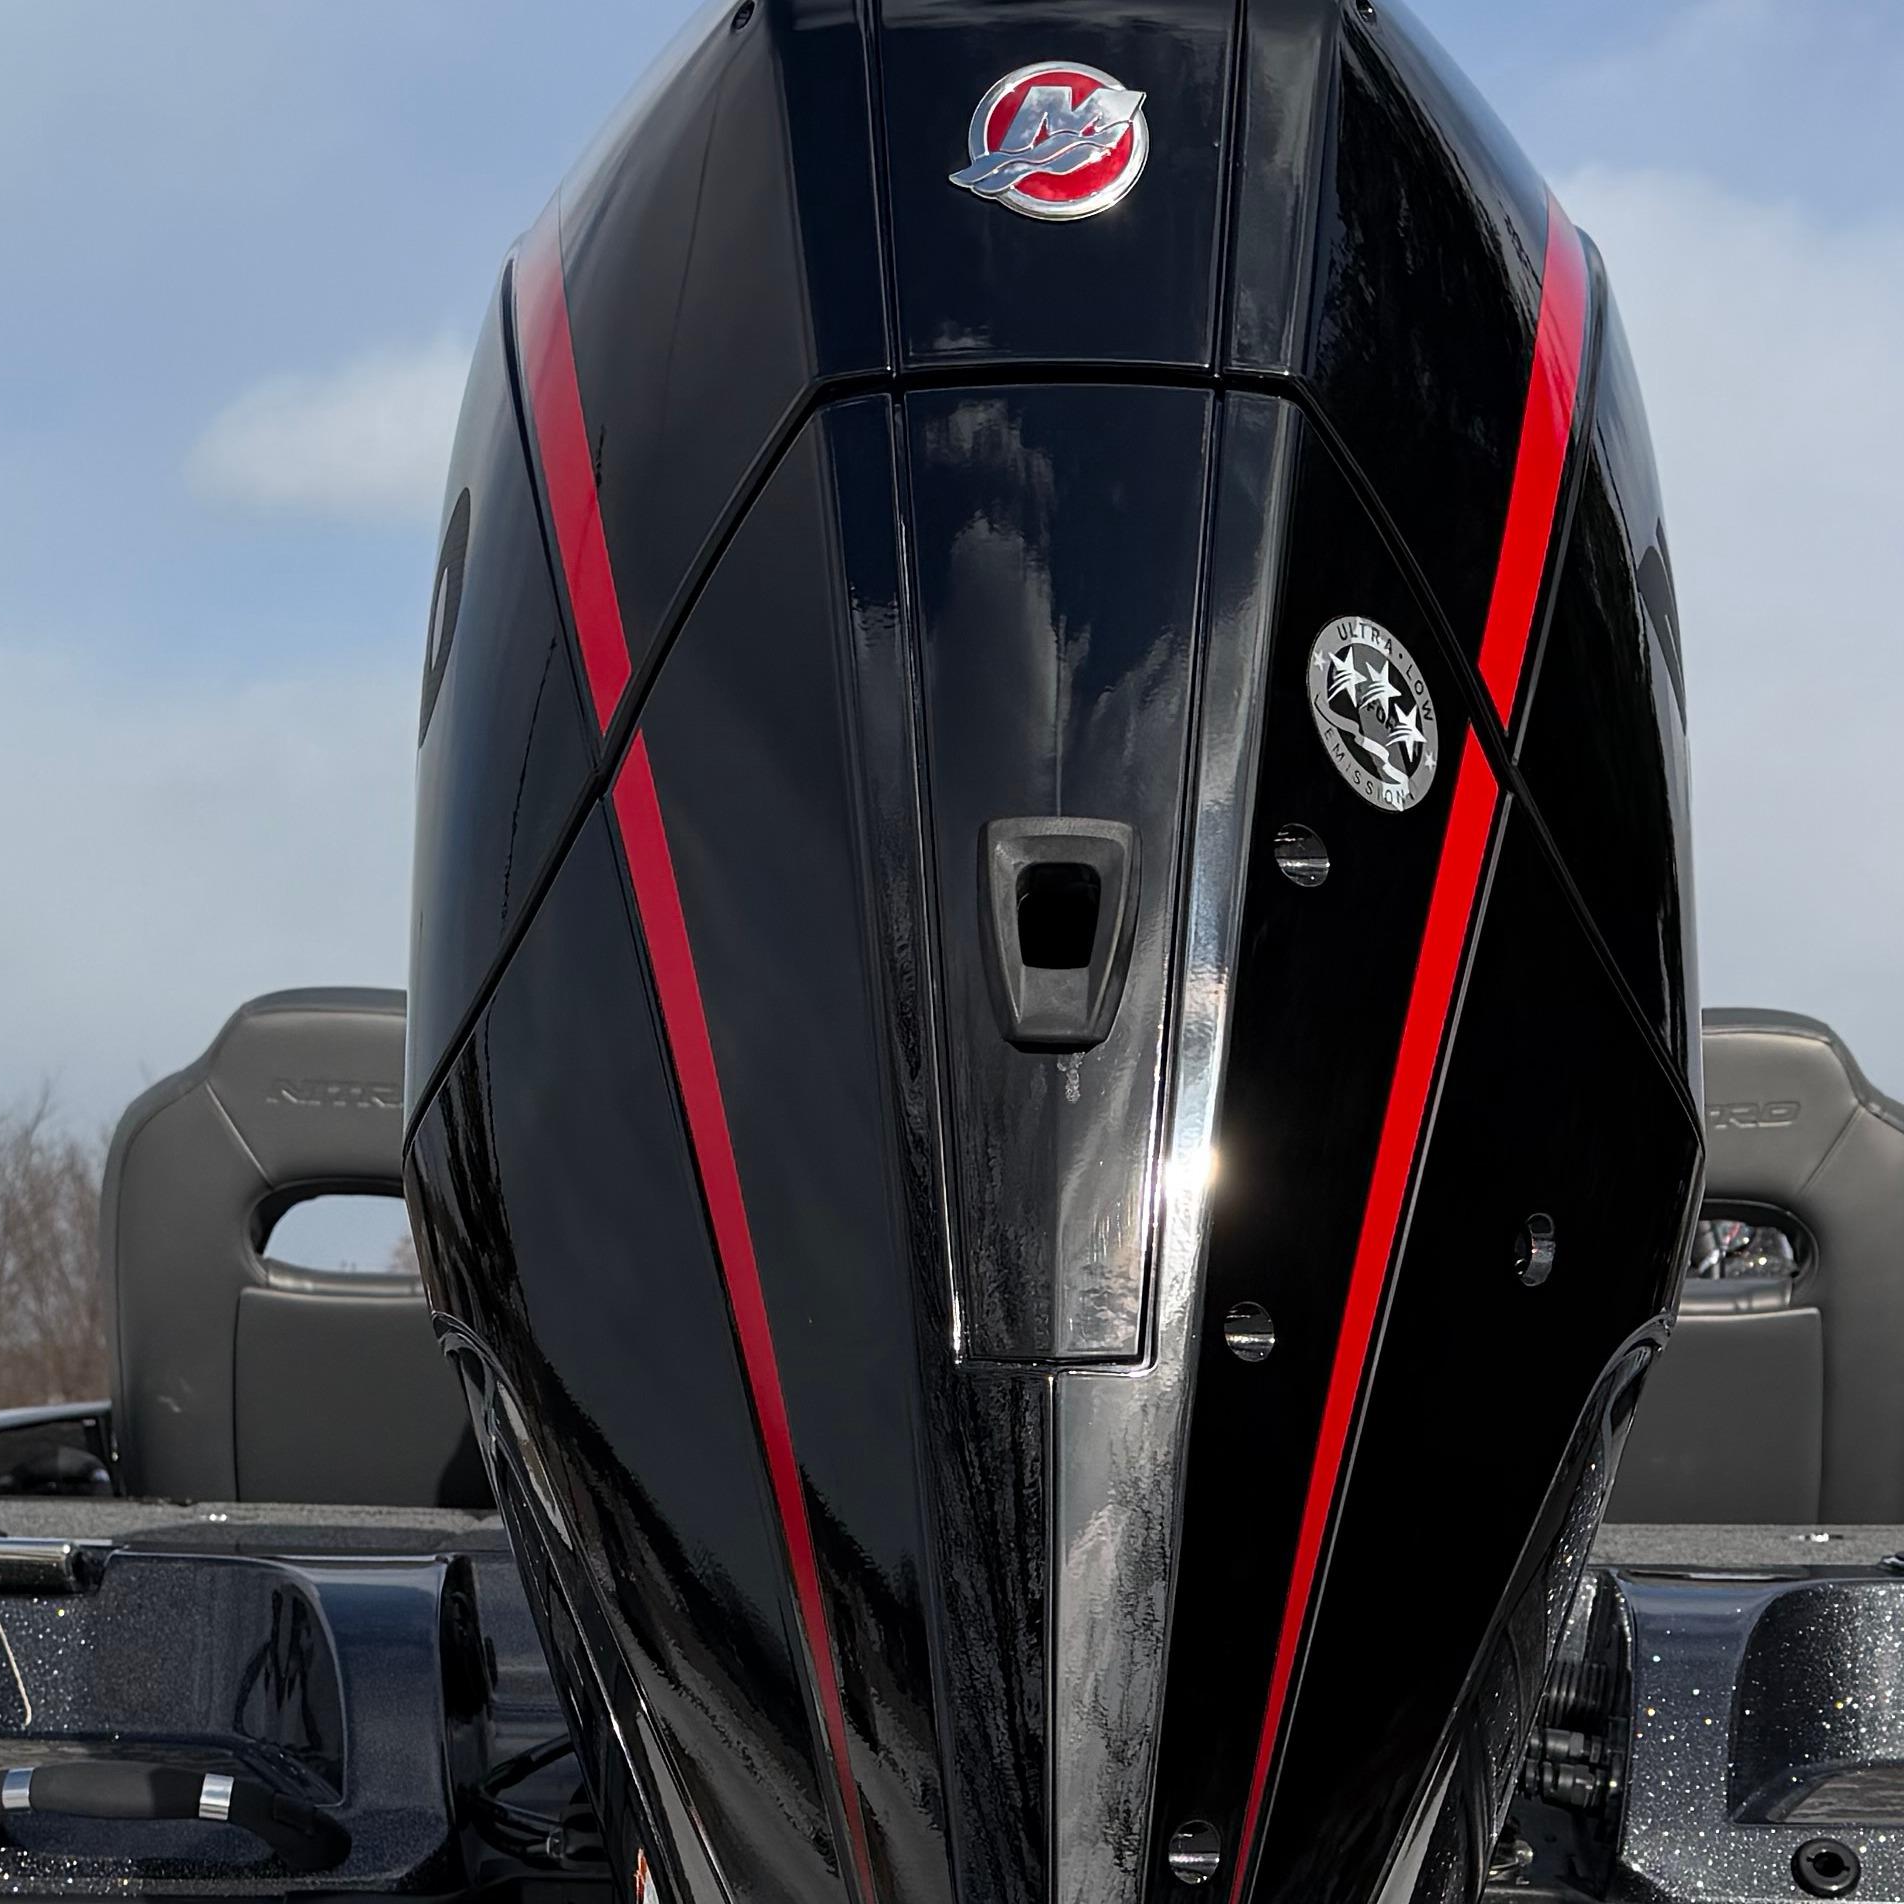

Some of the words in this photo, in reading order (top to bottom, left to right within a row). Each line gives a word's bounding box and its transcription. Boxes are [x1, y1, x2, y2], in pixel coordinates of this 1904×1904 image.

[1337, 622, 1393, 655] ULTRA
[1406, 664, 1435, 722] LOW
[1323, 727, 1406, 804] EMISSION
